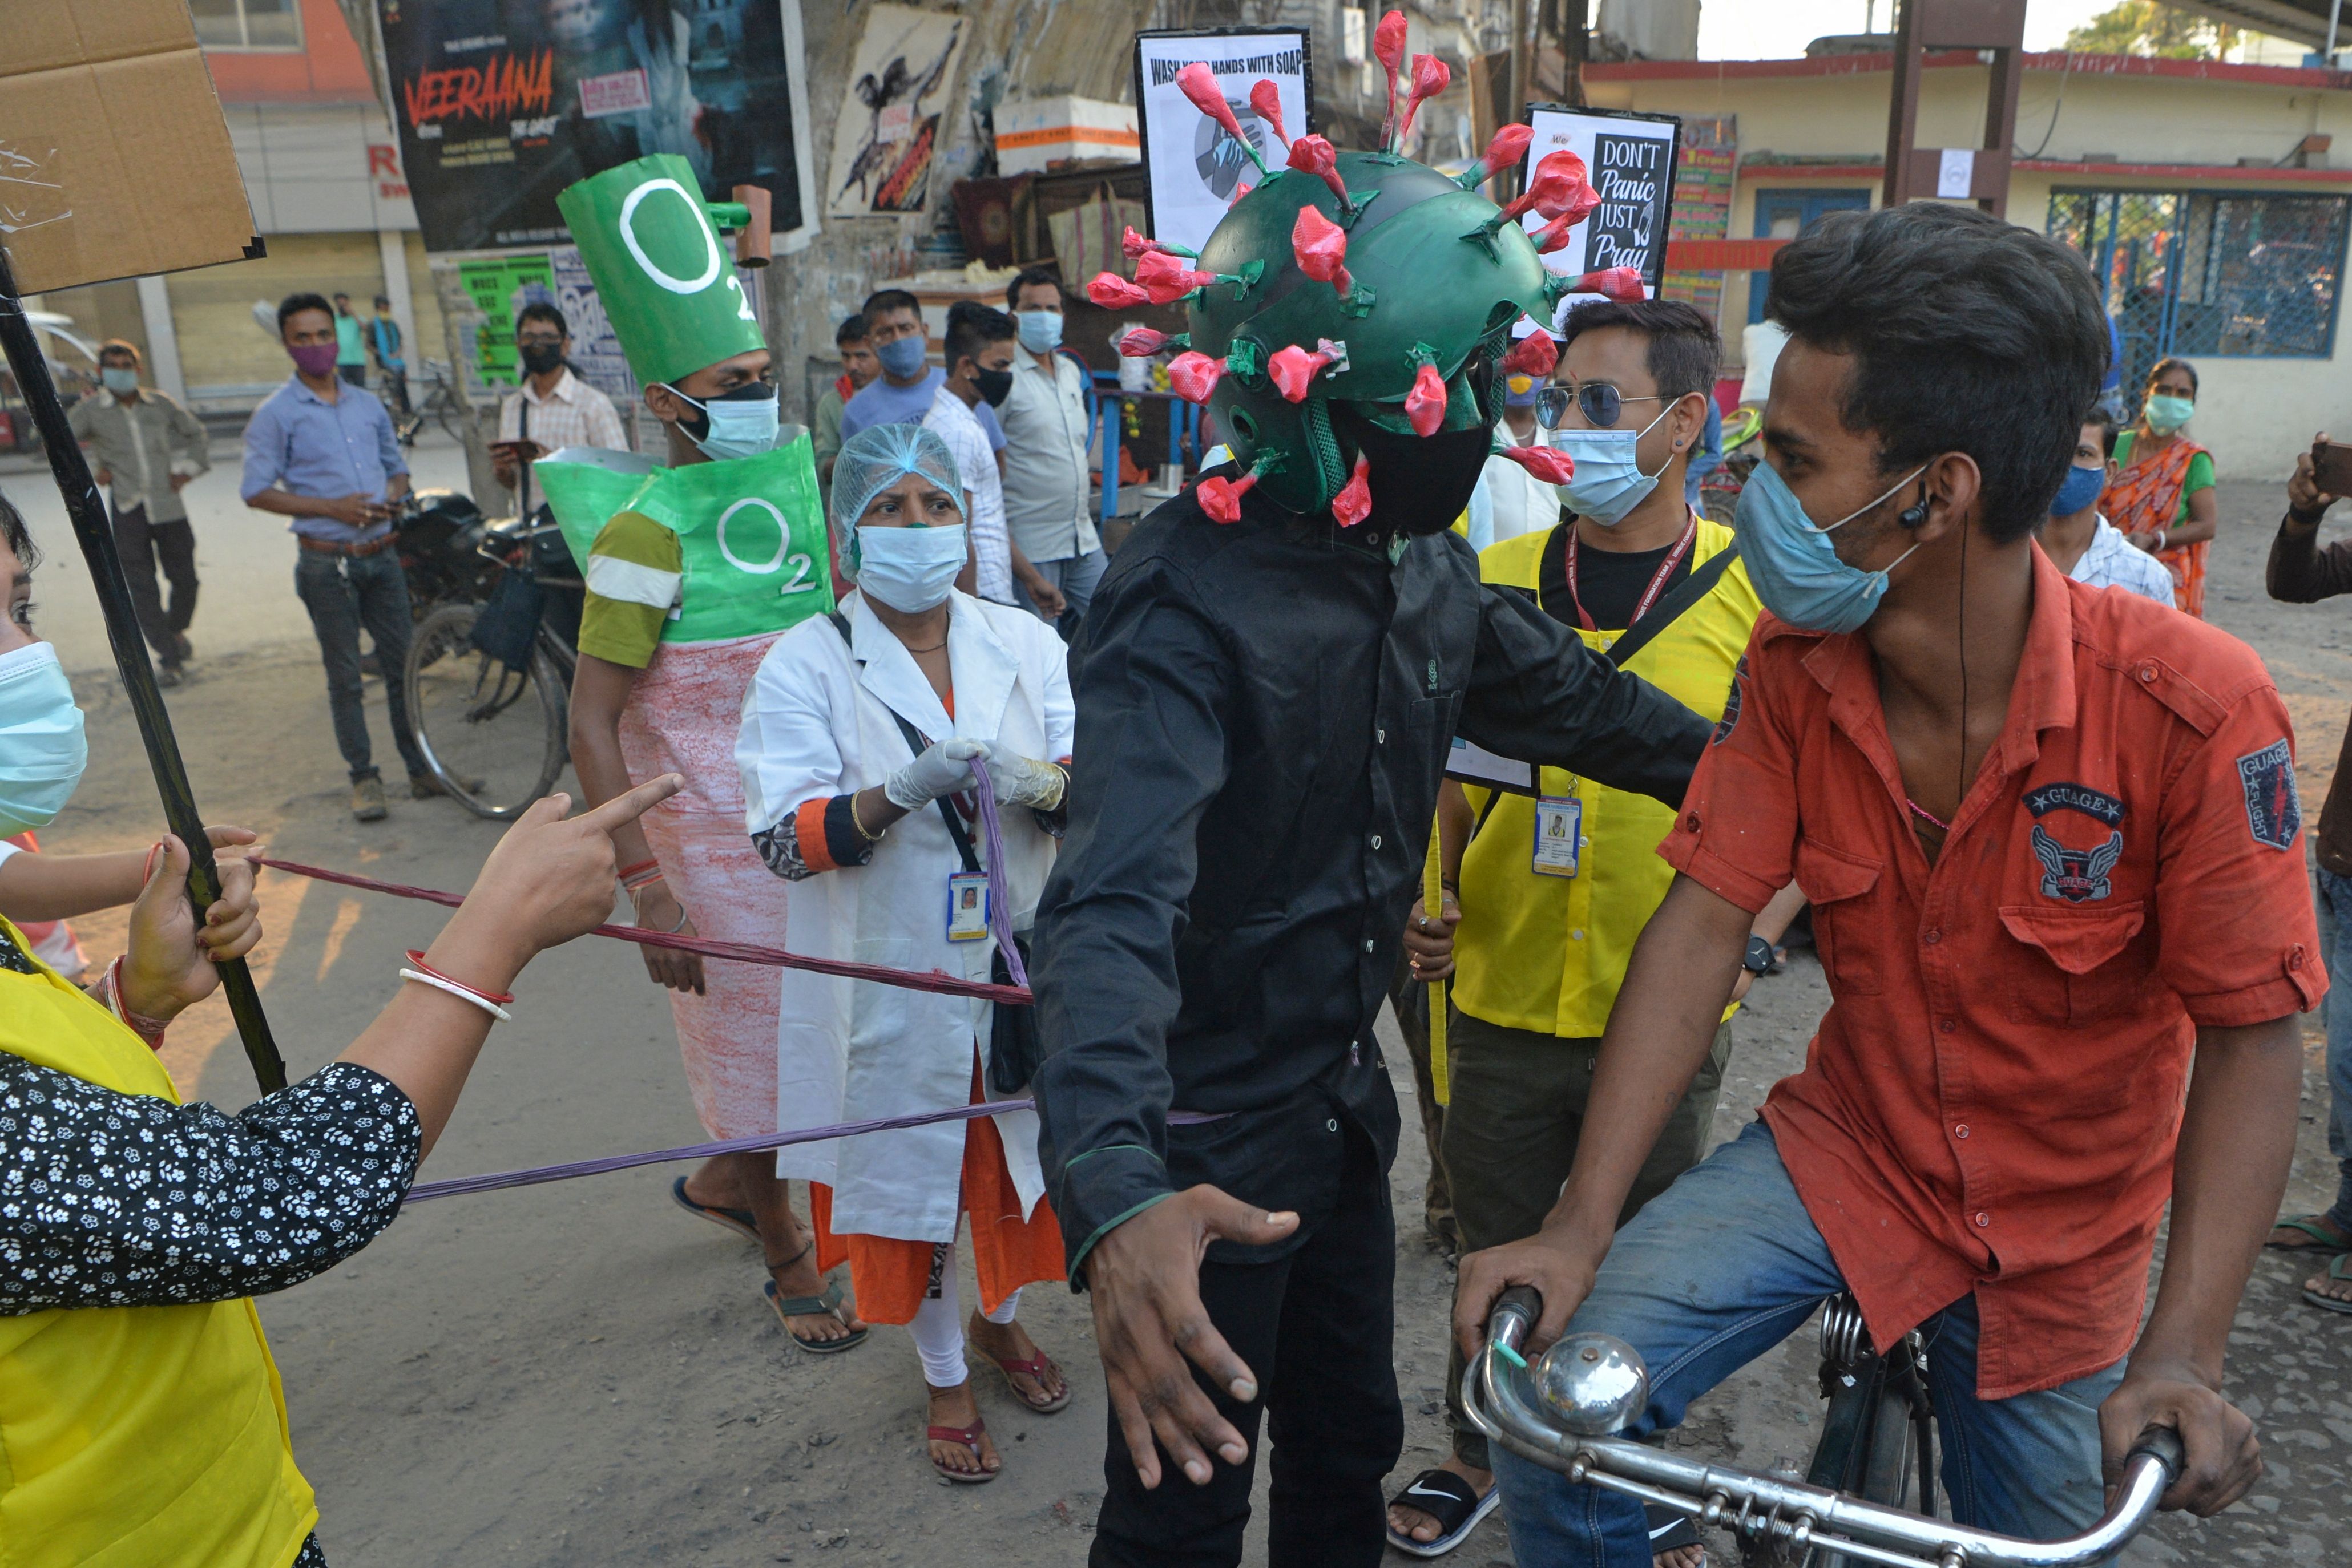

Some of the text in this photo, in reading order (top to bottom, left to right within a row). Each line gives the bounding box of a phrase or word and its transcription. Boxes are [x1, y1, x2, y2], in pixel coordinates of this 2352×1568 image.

[1212, 59, 1245, 75] HANDS
[1247, 56, 1274, 74] WITH
[1276, 49, 1302, 75] SOAP
[404, 46, 553, 128] VEERAANA
[1552, 135, 1568, 144] We
[1603, 140, 1660, 169] DON'T
[1601, 169, 1656, 202] Panic
[1597, 203, 1637, 232] JUST
[1594, 234, 1649, 272] Pray
[1643, 577, 1662, 606] FOUNDATION
[1659, 564, 1670, 577] TEAM
[2242, 743, 2289, 775] GUAGE
[2048, 788, 2105, 811] GUAGE
